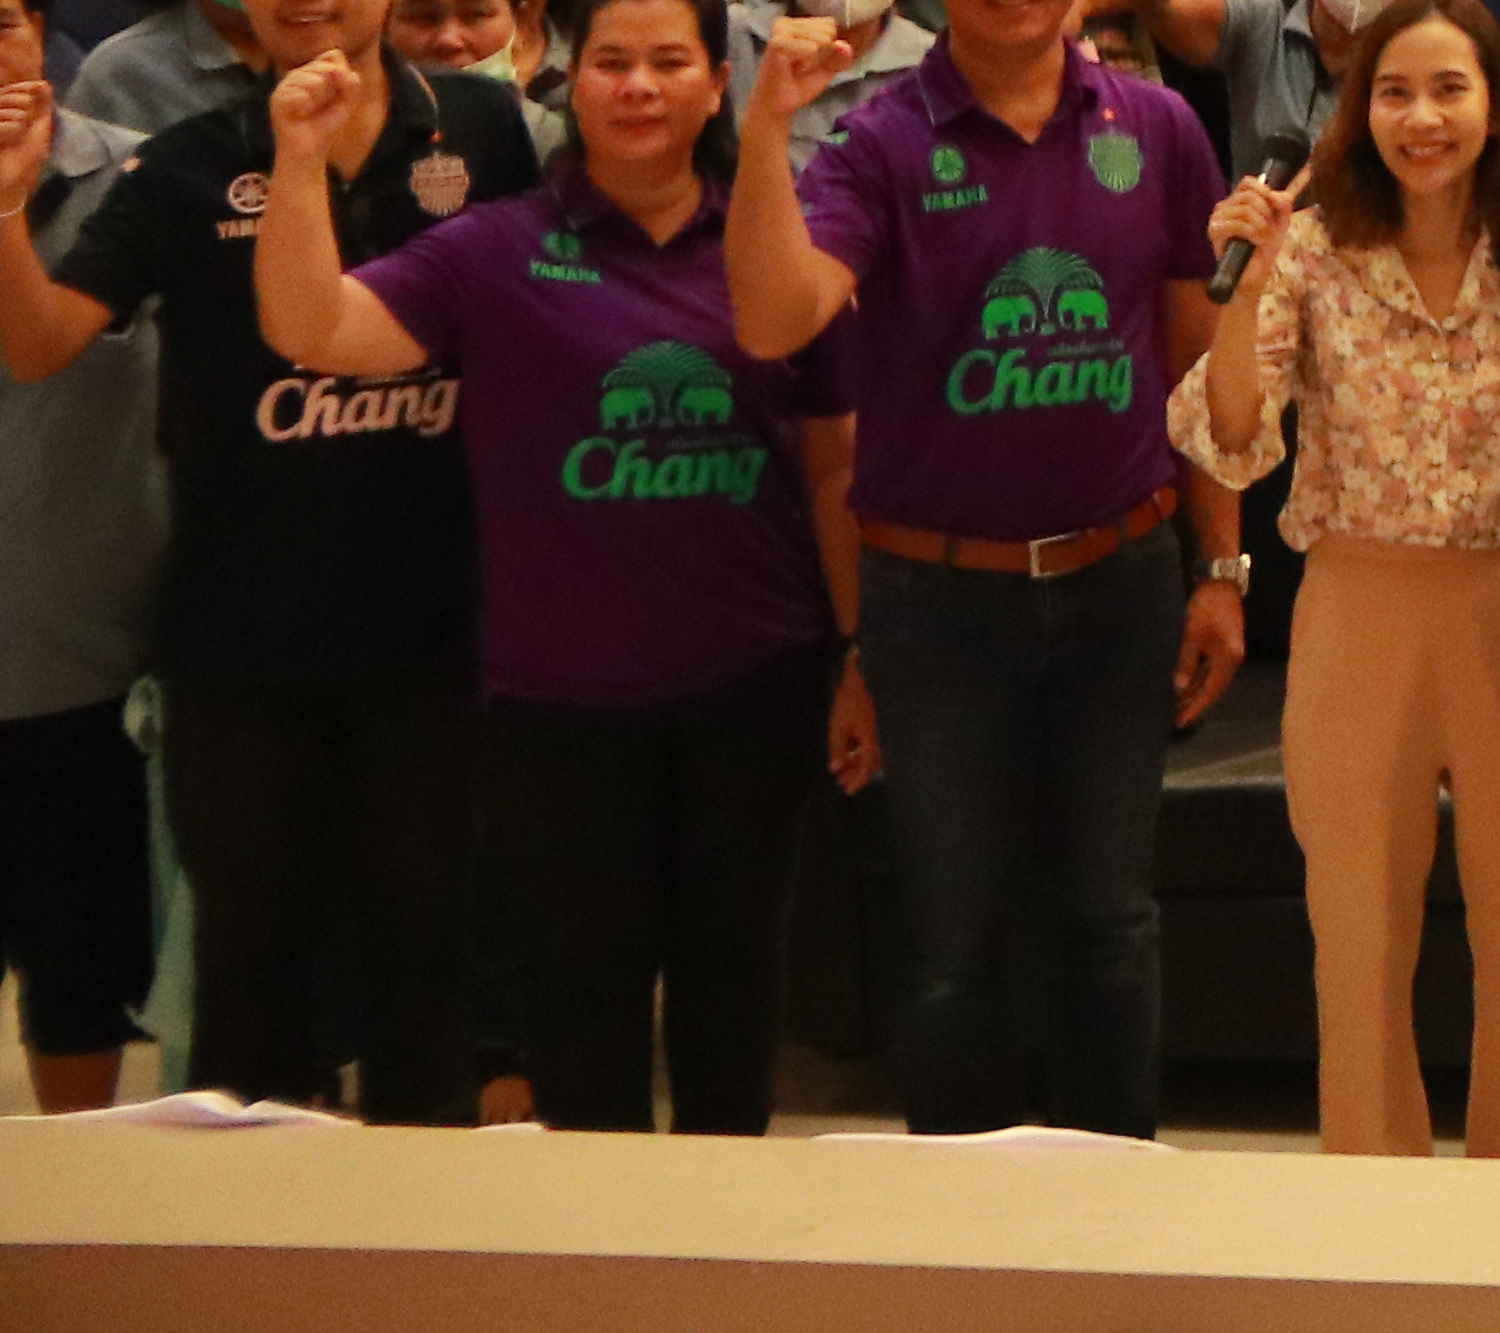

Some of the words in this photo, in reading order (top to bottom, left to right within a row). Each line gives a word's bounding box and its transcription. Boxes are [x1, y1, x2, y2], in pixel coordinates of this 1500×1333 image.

[922, 185, 988, 211] YAMAHA
[256, 376, 462, 442] Chang
[946, 348, 1134, 414] Chang
[561, 436, 768, 504] Chang
